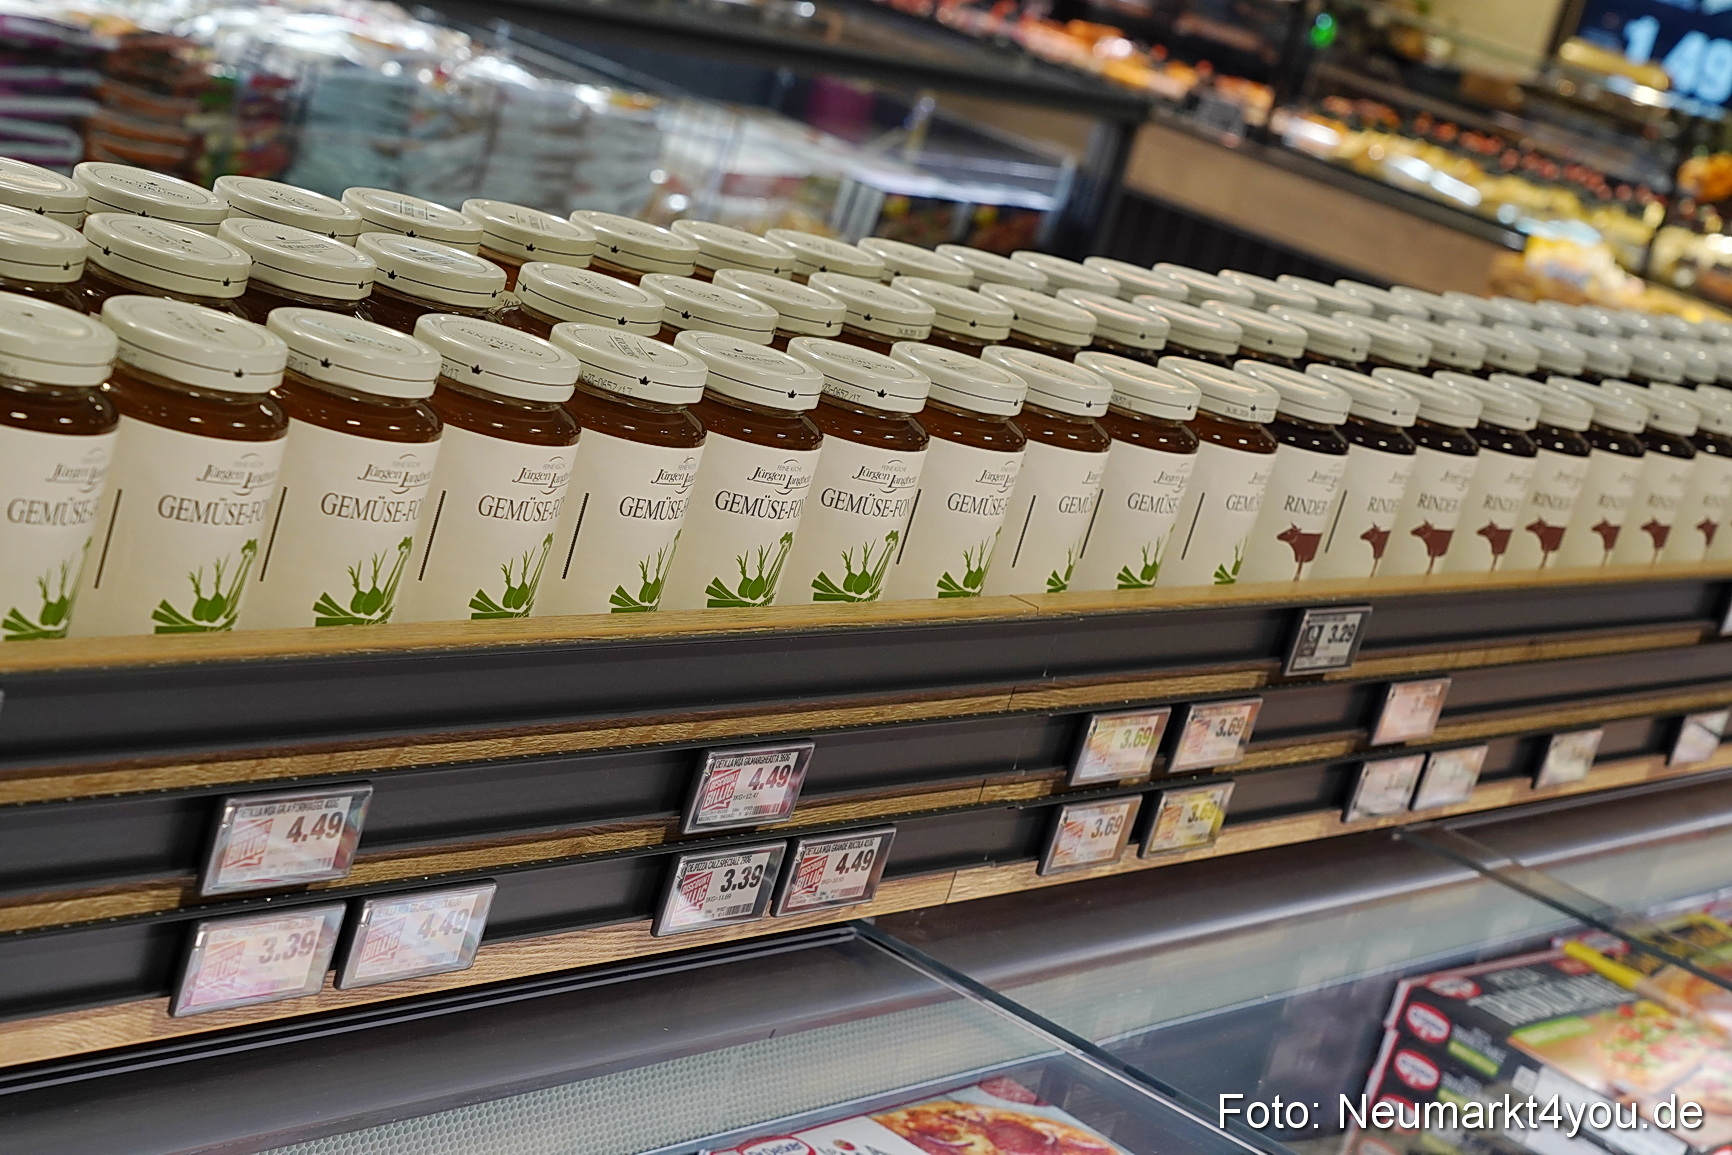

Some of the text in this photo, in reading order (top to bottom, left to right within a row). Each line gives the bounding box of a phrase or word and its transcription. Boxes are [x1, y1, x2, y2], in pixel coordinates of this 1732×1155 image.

[512, 467, 551, 483] Jürgen
[650, 469, 684, 483] Jürgen
[747, 466, 786, 482] Jürgen
[852, 465, 890, 481] Jürgen
[1327, 623, 1356, 644] 3.29
[1119, 726, 1152, 749] 3.69
[1215, 716, 1246, 738] 3.69
[748, 764, 792, 791] 4.49
[703, 782, 737, 808] BILLIG
[286, 811, 343, 843] 4.49
[1091, 813, 1124, 839] 3.69
[835, 849, 875, 875] 4.49
[720, 864, 763, 893] 3.39
[795, 867, 823, 891] BILLIG
[416, 908, 470, 939] 4.49
[259, 930, 316, 964] 3.39
